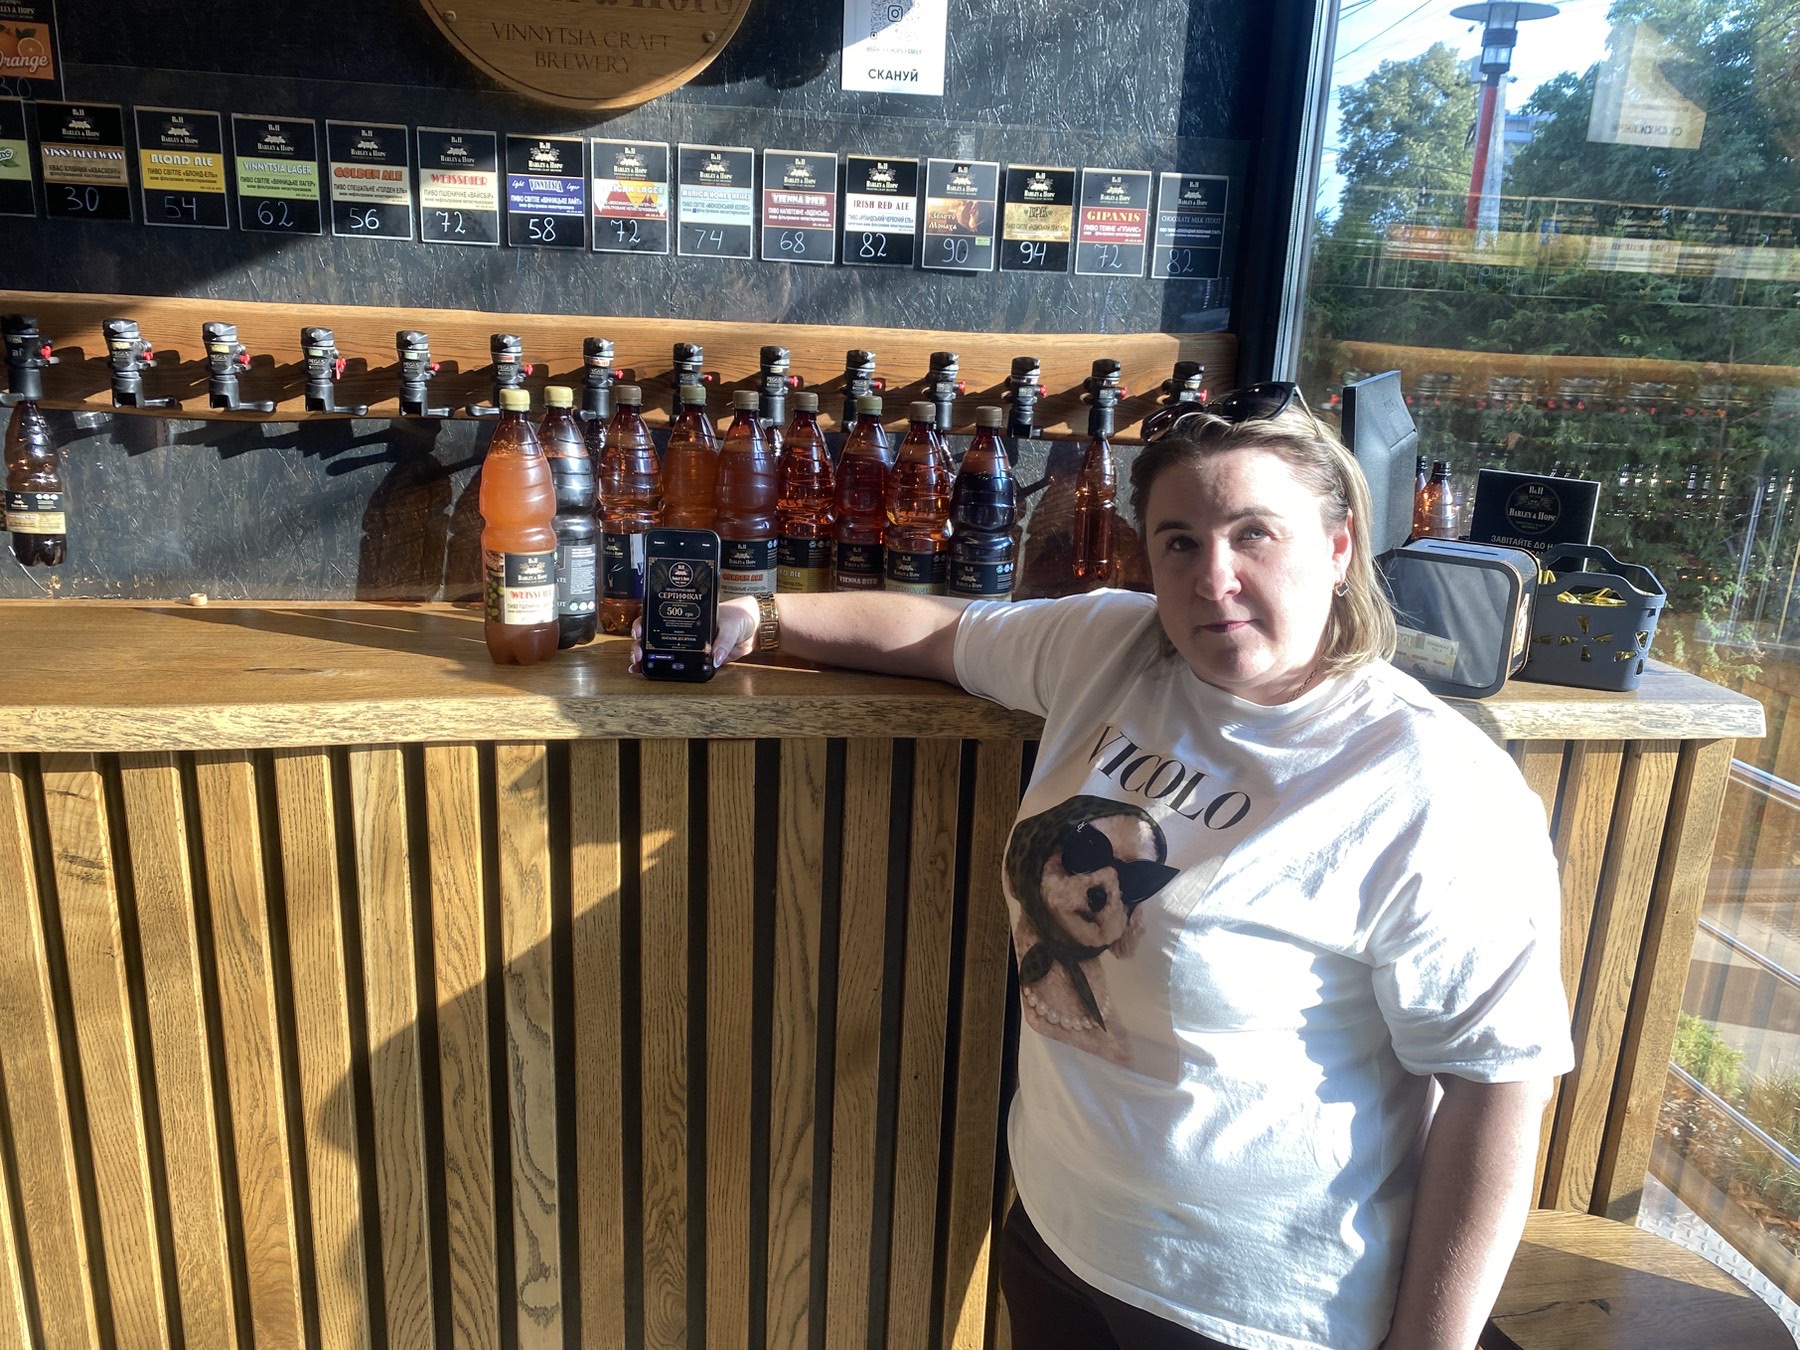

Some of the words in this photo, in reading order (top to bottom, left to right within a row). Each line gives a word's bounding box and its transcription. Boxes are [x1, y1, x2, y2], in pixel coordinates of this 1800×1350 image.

[491, 22, 596, 49] VINNYTSIA
[604, 33, 672, 51] CRAFT
[534, 51, 632, 74] BREWERY
[868, 68, 919, 82] СКАНУЙ
[151, 153, 191, 166] BLOND
[195, 156, 214, 167] ALE
[243, 161, 285, 173] VINNYTSIA
[287, 165, 312, 175] LAGER
[334, 167, 380, 180] GOLDEN
[382, 170, 403, 181] ALE
[430, 173, 488, 186] WEISSBIER
[64, 186, 99, 212] 30
[424, 189, 439, 197] ПИВО
[165, 196, 197, 220] 54
[258, 201, 293, 227] 62
[854, 200, 875, 209] IRISH
[878, 201, 893, 210] RED
[896, 202, 910, 211] ALE
[1087, 210, 1141, 223] GIPANIS
[350, 207, 380, 230] 56
[436, 210, 466, 234] 72
[529, 217, 556, 241] 58
[611, 219, 641, 243] 72
[695, 229, 724, 250] 74
[780, 231, 806, 254] 68
[860, 232, 886, 258] 82
[942, 238, 969, 264] 90
[1020, 241, 1046, 266] 94
[1094, 244, 1123, 269] 72
[1167, 248, 1194, 274] 82
[1529, 485, 1544, 495] B&H
[1509, 507, 1532, 518] BARLEY
[1538, 511, 1557, 522] HOPS
[1491, 535, 1533, 548] ЗАВІТАЙТЕ
[1534, 542, 1546, 550] ДО
[658, 592, 703, 601] СЕРТИФІКАТ
[667, 606, 683, 616] 500
[1087, 726, 1251, 831] VICOLO
